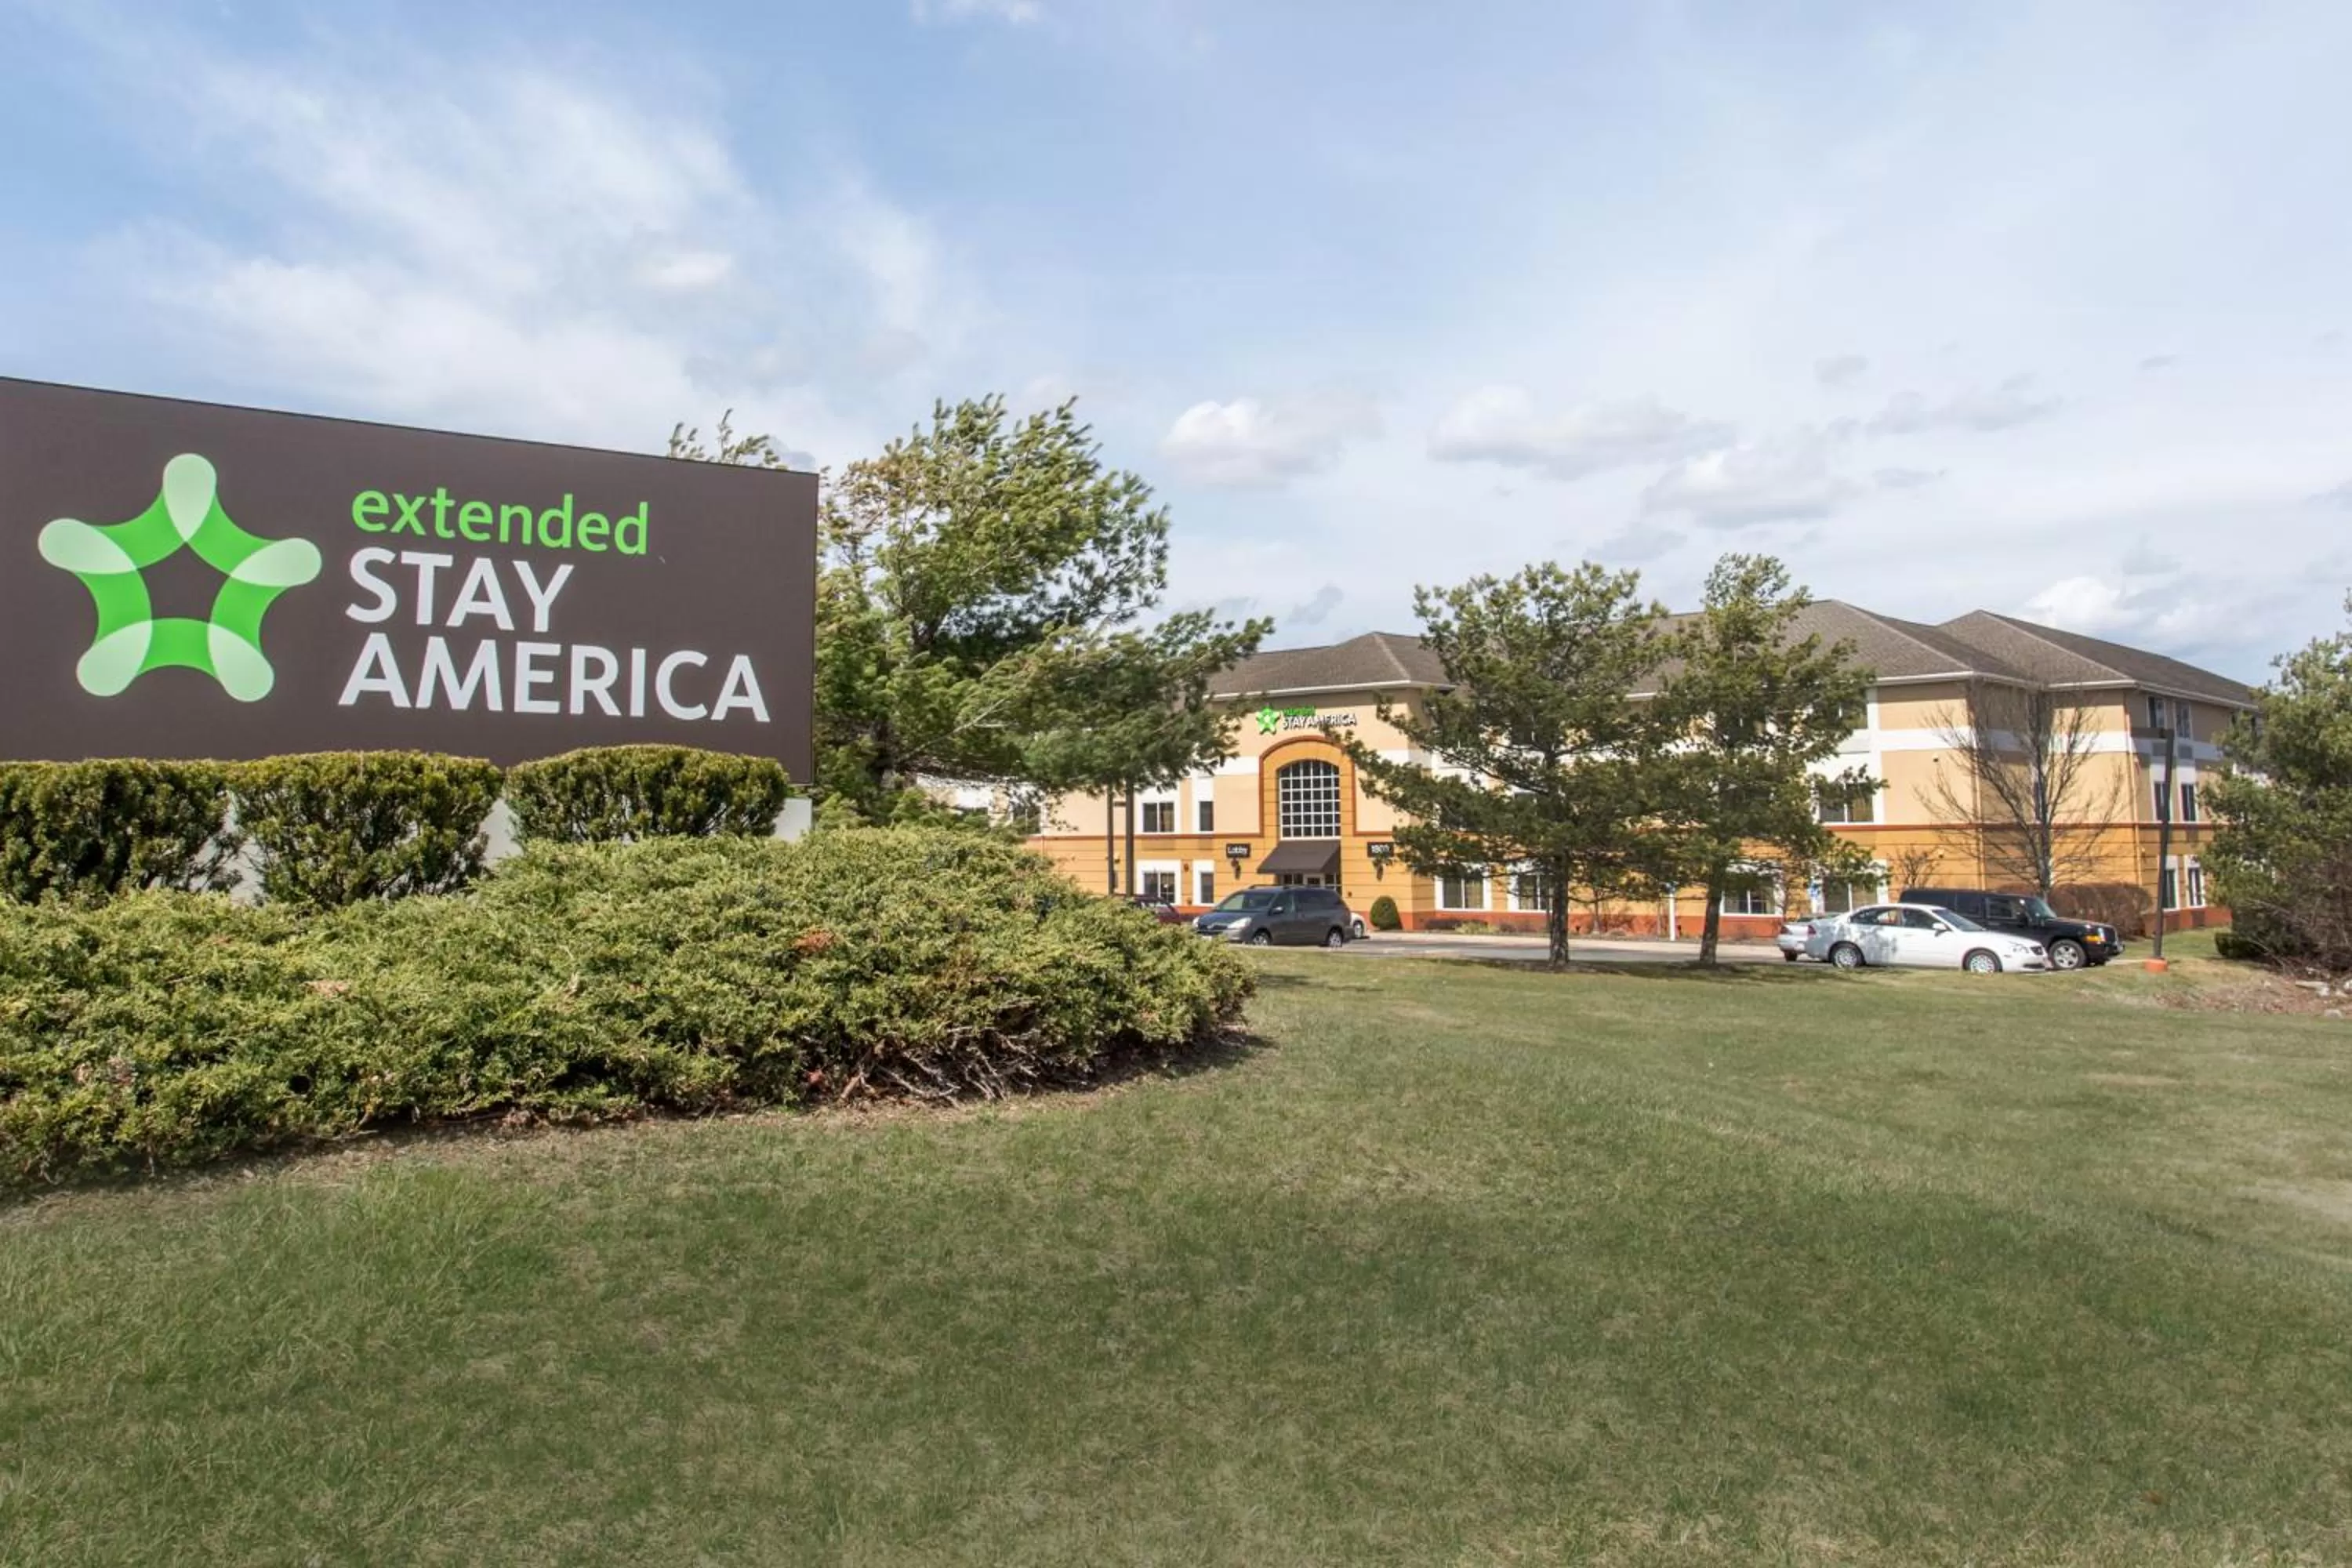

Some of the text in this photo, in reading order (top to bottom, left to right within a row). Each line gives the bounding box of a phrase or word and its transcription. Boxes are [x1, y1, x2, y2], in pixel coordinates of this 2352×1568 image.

[352, 488, 648, 553] extended
[346, 546, 574, 633] STAY
[338, 632, 771, 722] AMERICA
